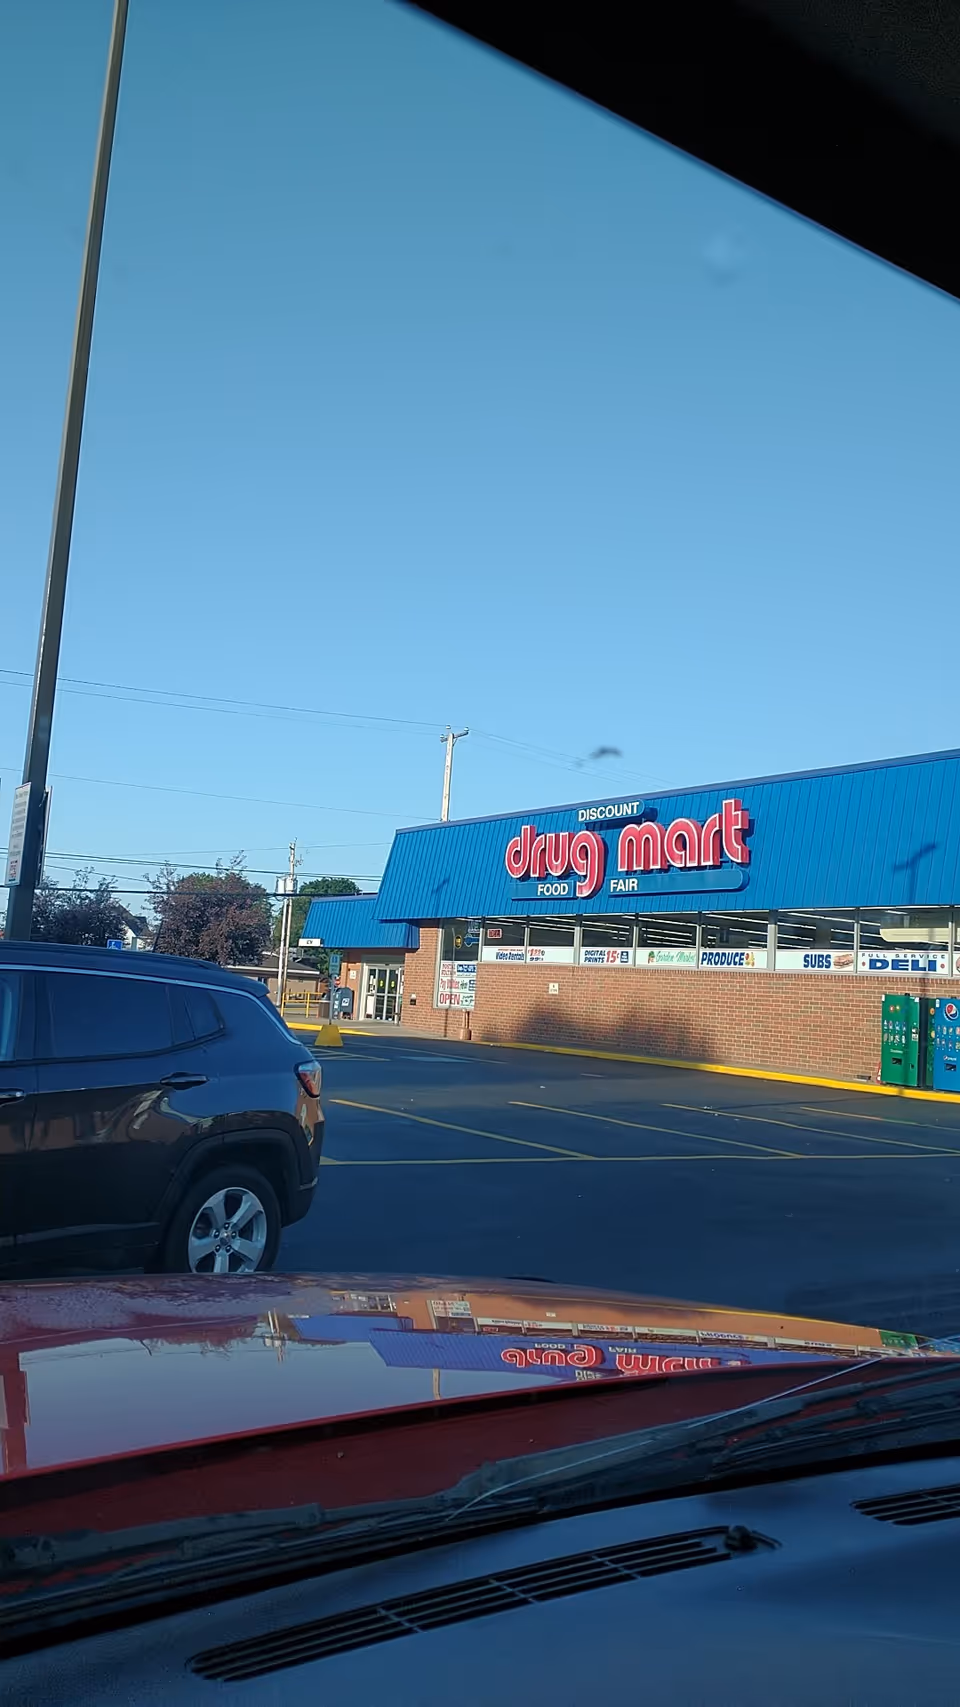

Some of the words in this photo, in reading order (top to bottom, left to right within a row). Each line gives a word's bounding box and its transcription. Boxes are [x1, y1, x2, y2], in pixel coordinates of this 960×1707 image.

[578, 802, 640, 822] DISCOUNT
[505, 825, 605, 898] drug
[617, 798, 750, 872] mart
[537, 882, 569, 896] FOOD
[610, 878, 638, 892] FAIR
[700, 951, 745, 966] PRODUCE
[803, 953, 832, 969] SUBS
[868, 958, 937, 972] DELI
[439, 993, 460, 1005] OPEN
